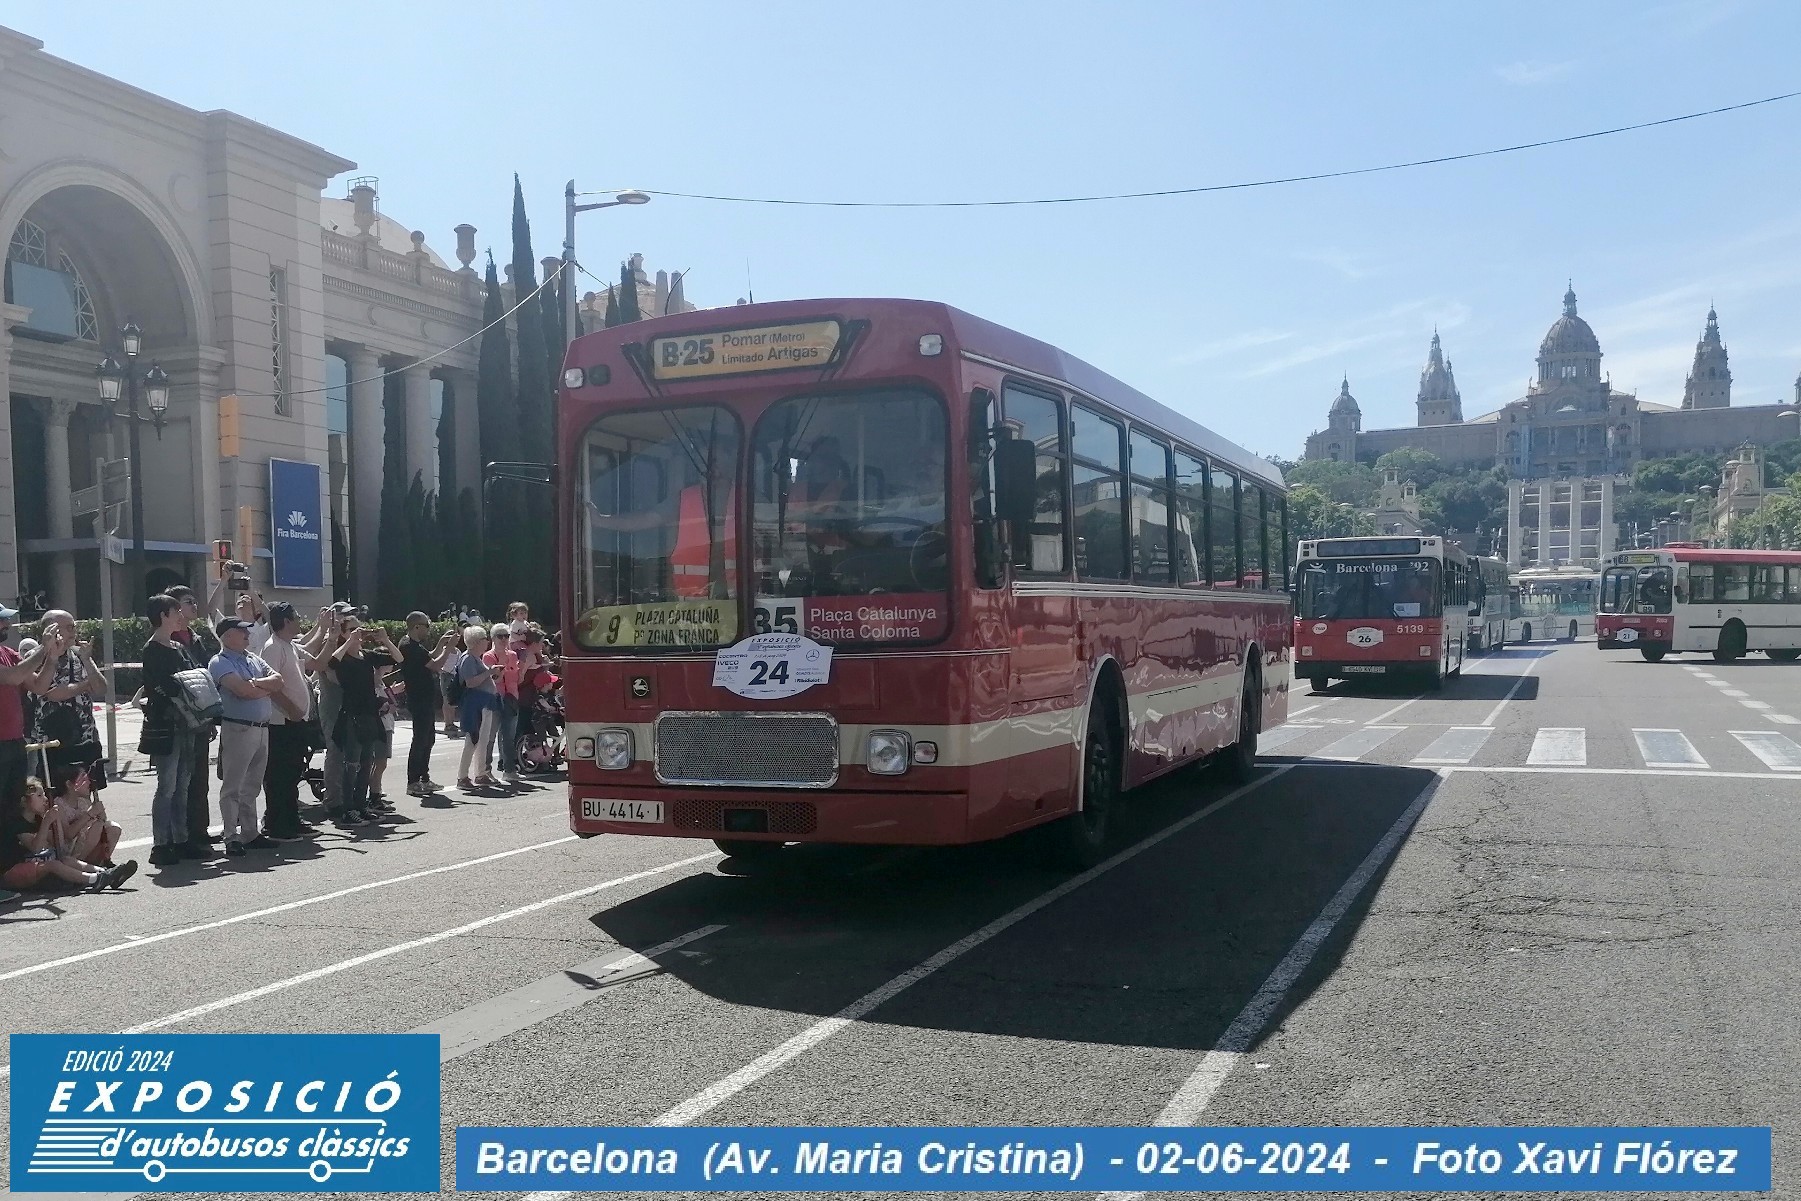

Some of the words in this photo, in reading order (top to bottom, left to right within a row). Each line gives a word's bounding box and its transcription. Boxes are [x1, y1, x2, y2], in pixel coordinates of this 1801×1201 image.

[722, 332, 767, 348] Pomar
[769, 332, 805, 344] (Metro)
[722, 351, 764, 365] Limitado
[767, 345, 818, 362] Artigas
[277, 527, 289, 538] Fira
[289, 528, 319, 540] Barcelona
[1336, 562, 1398, 574] Barcelona
[634, 610, 665, 625] PLAZA
[668, 606, 720, 625] CATALUÑA
[810, 608, 853, 625] Plaça
[857, 606, 937, 623] Catalunya
[606, 614, 620, 644] 9
[647, 629, 676, 644] ZONA
[679, 628, 720, 644] FRANCA
[811, 625, 855, 640] Santa
[859, 624, 921, 639] Coloma
[1358, 635, 1372, 643] 26
[748, 660, 789, 686] 24
